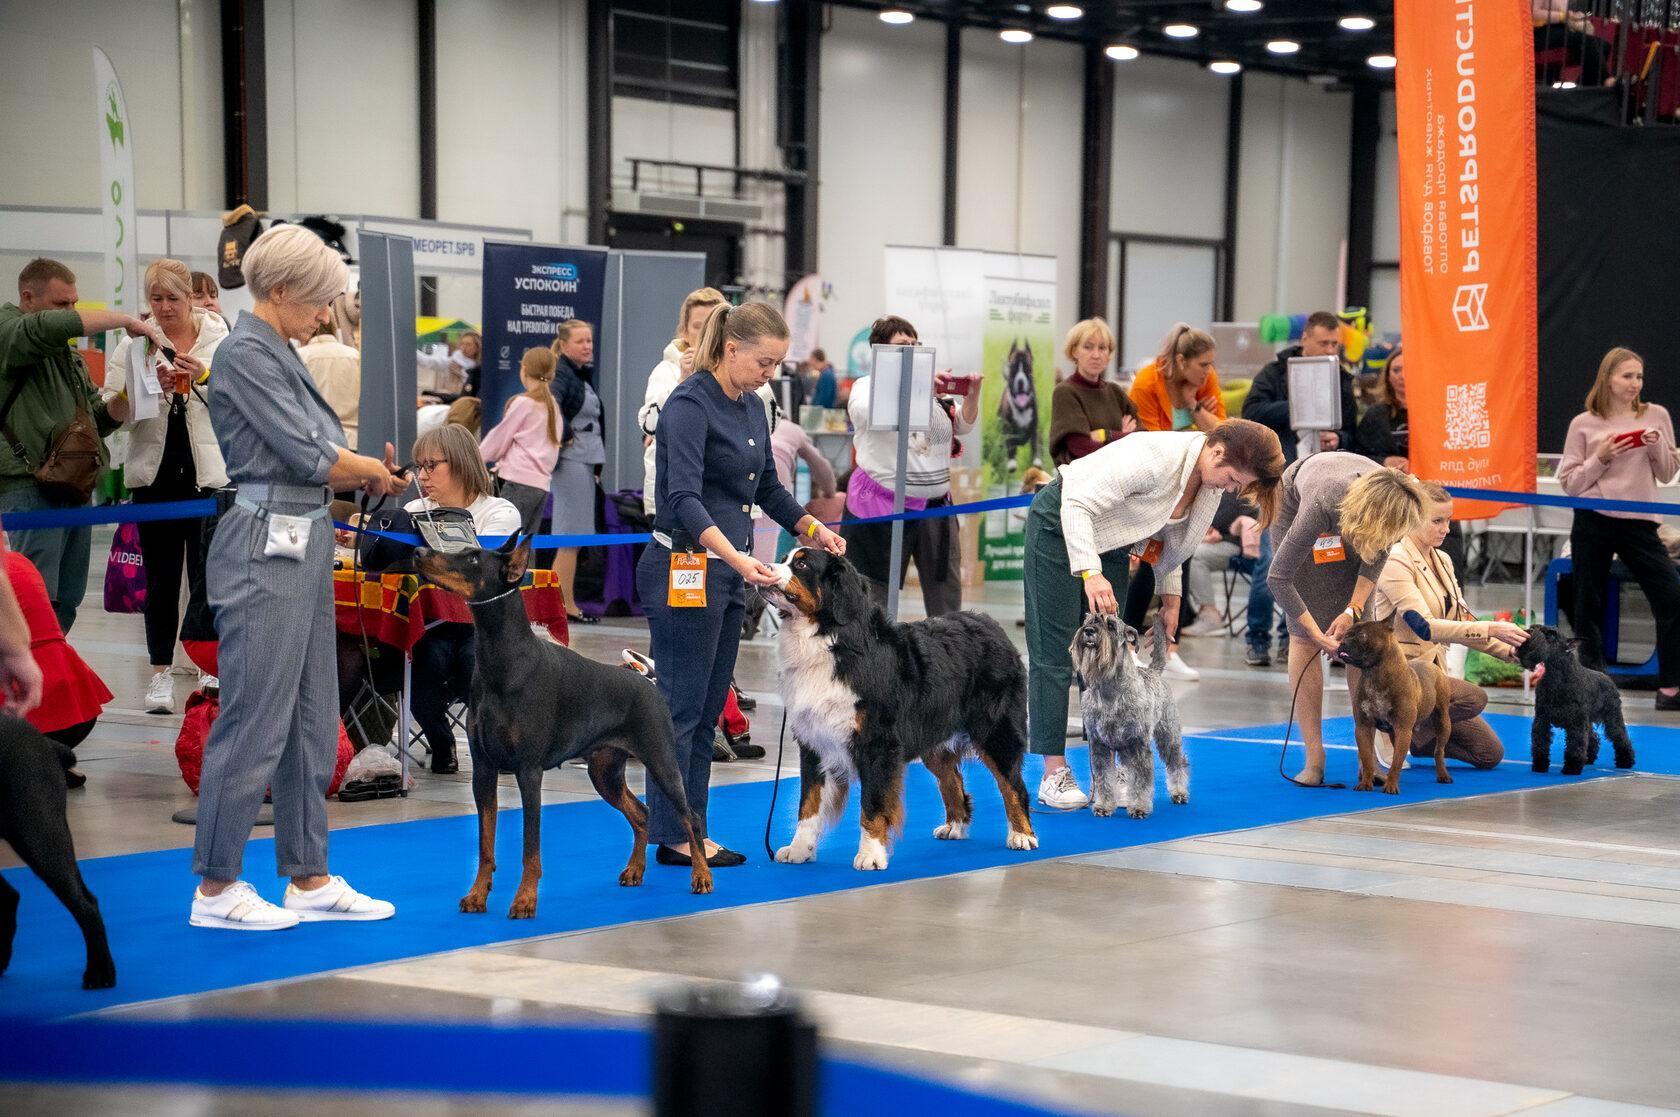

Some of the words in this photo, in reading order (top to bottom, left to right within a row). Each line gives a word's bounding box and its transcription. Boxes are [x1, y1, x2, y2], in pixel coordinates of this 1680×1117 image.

[531, 264, 573, 276] ЭКСПРЕСС
[521, 303, 548, 317] БЫСТРАЯ
[549, 305, 575, 319] ПОБЕДА
[507, 320, 521, 335] НАД
[522, 319, 550, 334] ТРЕВОГОЙ
[678, 572, 700, 585] 025
